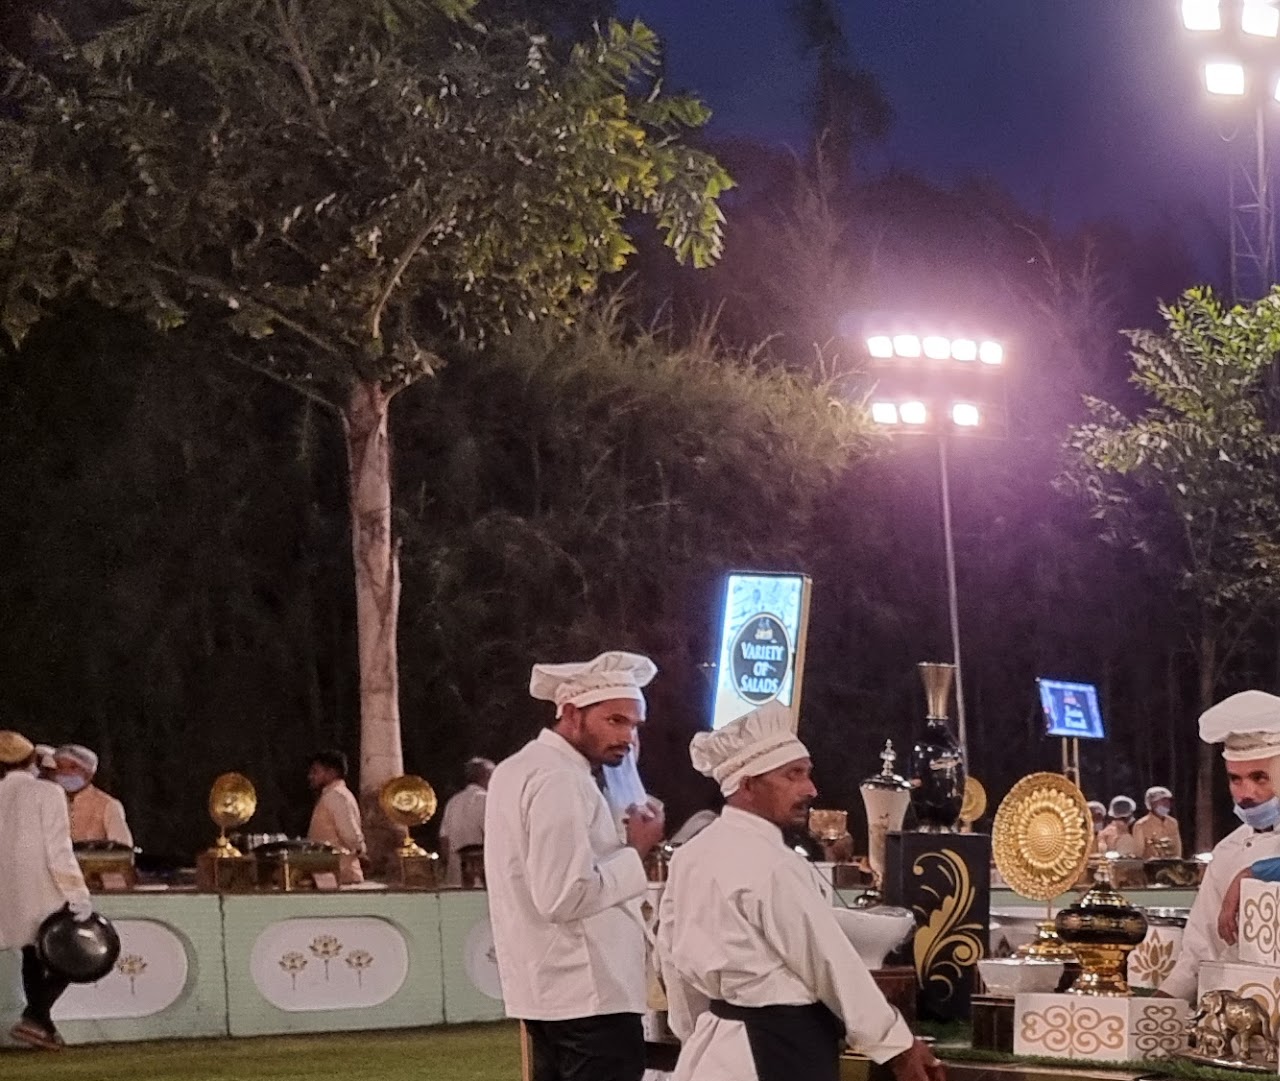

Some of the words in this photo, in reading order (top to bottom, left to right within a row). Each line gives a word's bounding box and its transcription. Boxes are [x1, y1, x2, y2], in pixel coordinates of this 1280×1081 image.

[741, 641, 785, 661] VARIETY
[753, 661, 770, 677] OF
[740, 675, 779, 693] SALADS
